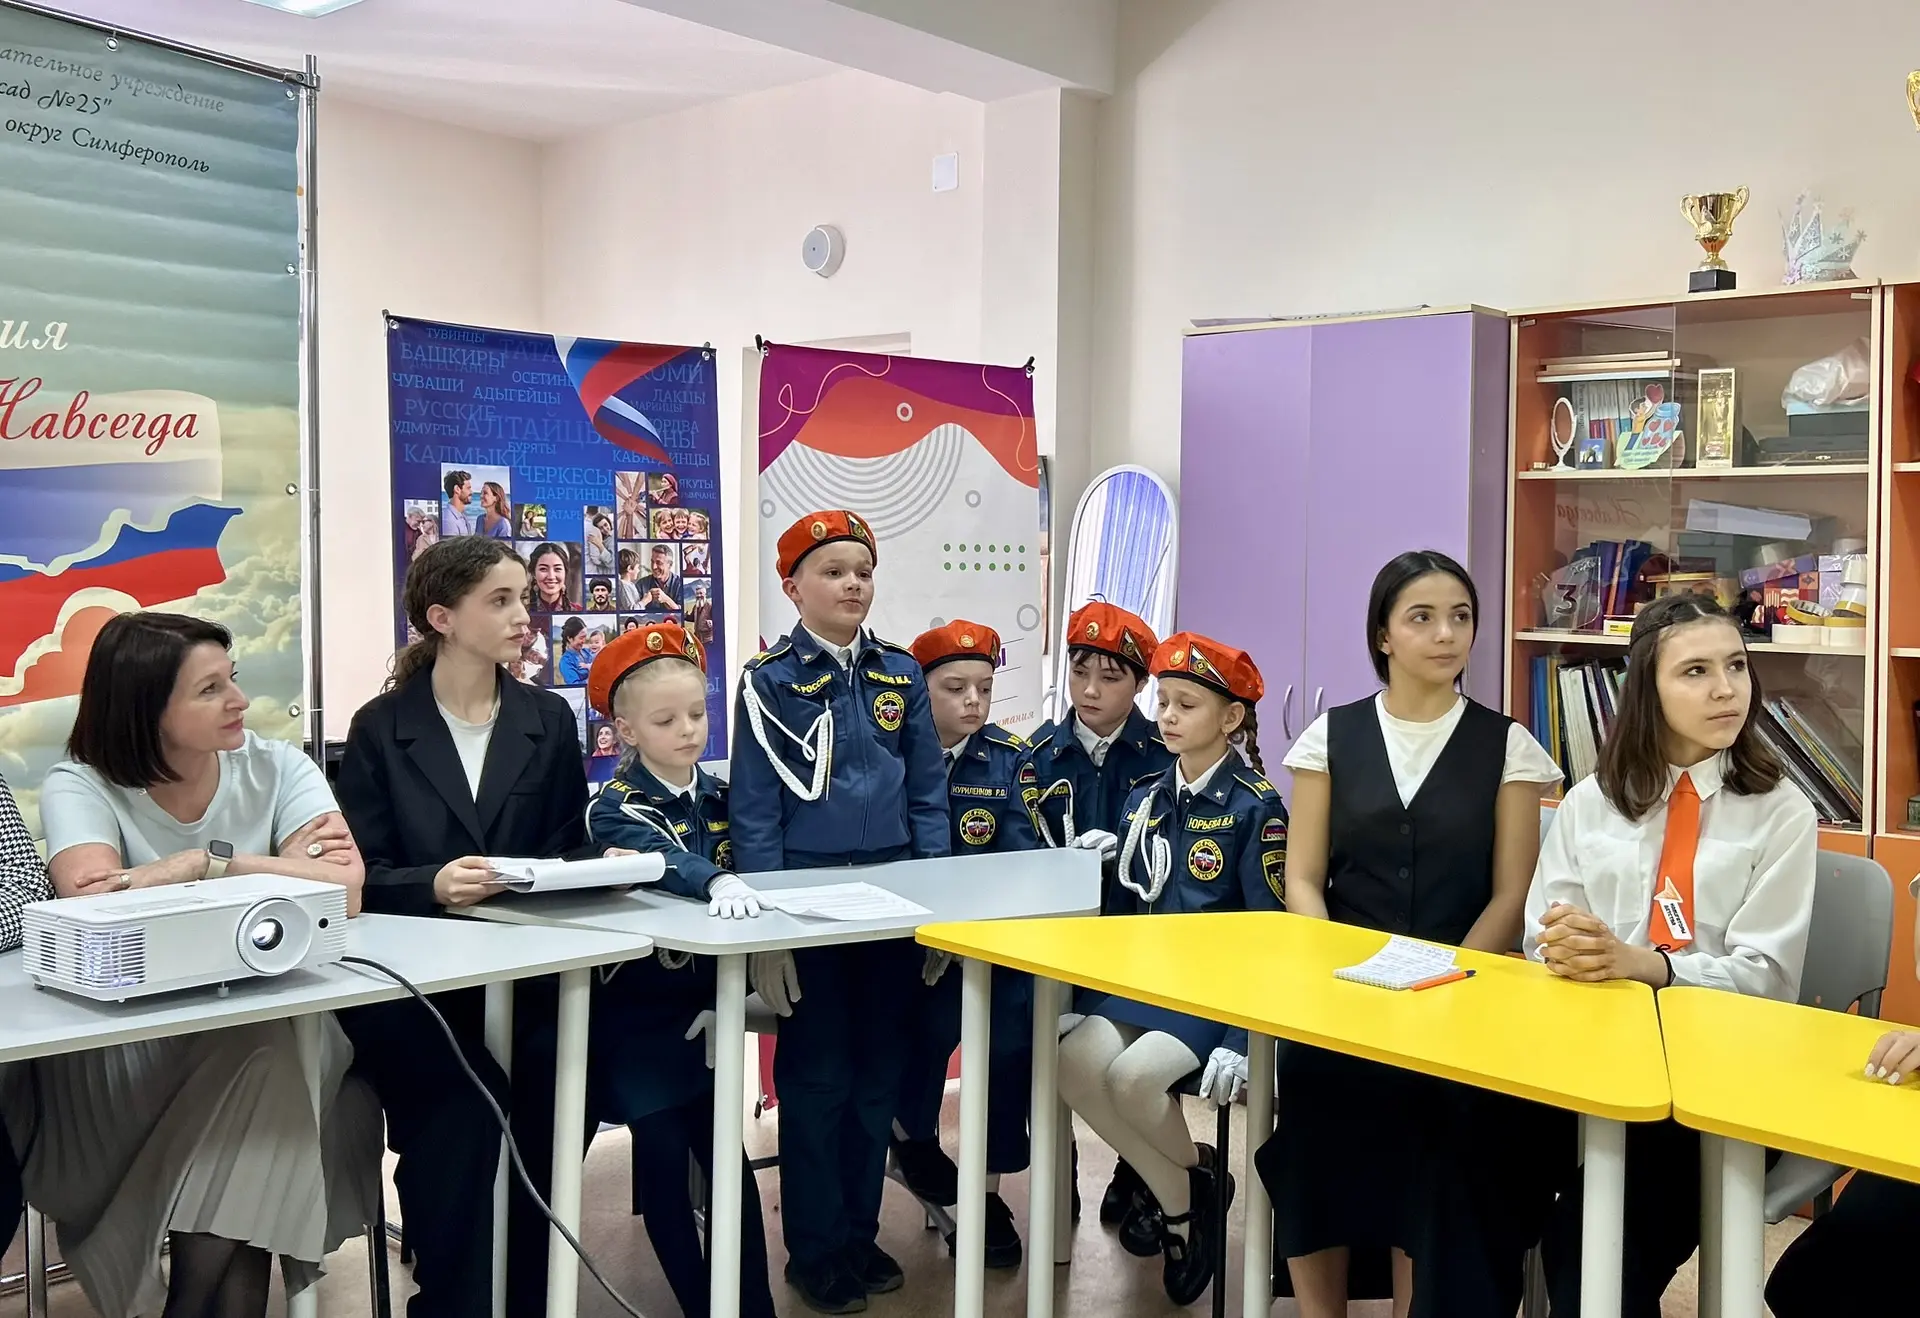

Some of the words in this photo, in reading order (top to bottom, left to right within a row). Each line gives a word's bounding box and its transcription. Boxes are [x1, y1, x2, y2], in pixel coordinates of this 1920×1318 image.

[0, 48, 103, 82] ательное
[110, 72, 225, 112] учреждение
[5, 117, 62, 144] округ
[72, 127, 210, 173] Симферополь
[426, 327, 485, 344] ТУВИНЦЫ
[401, 342, 505, 368] БАШКИРЫ
[500, 338, 559, 364] ТАТА
[392, 373, 464, 392] ЧУВАШИ
[473, 386, 561, 406] АДЫГЕЙЦЫ
[653, 389, 706, 406] ЛАКЦЫ
[0, 376, 199, 456] Навсегда
[405, 399, 496, 421] РУССКИЕ
[393, 420, 459, 437] УДМУРТЫ
[650, 418, 699, 433] ОРДВА
[404, 443, 527, 467] КАЛМЫКИ
[508, 441, 556, 455] БУРЯТЫ
[519, 466, 613, 486] ЧЕРКЕСЫ
[679, 478, 714, 489] ЯКУТЫ
[1554, 583, 1578, 614] 3
[996, 711, 1034, 726] итания
